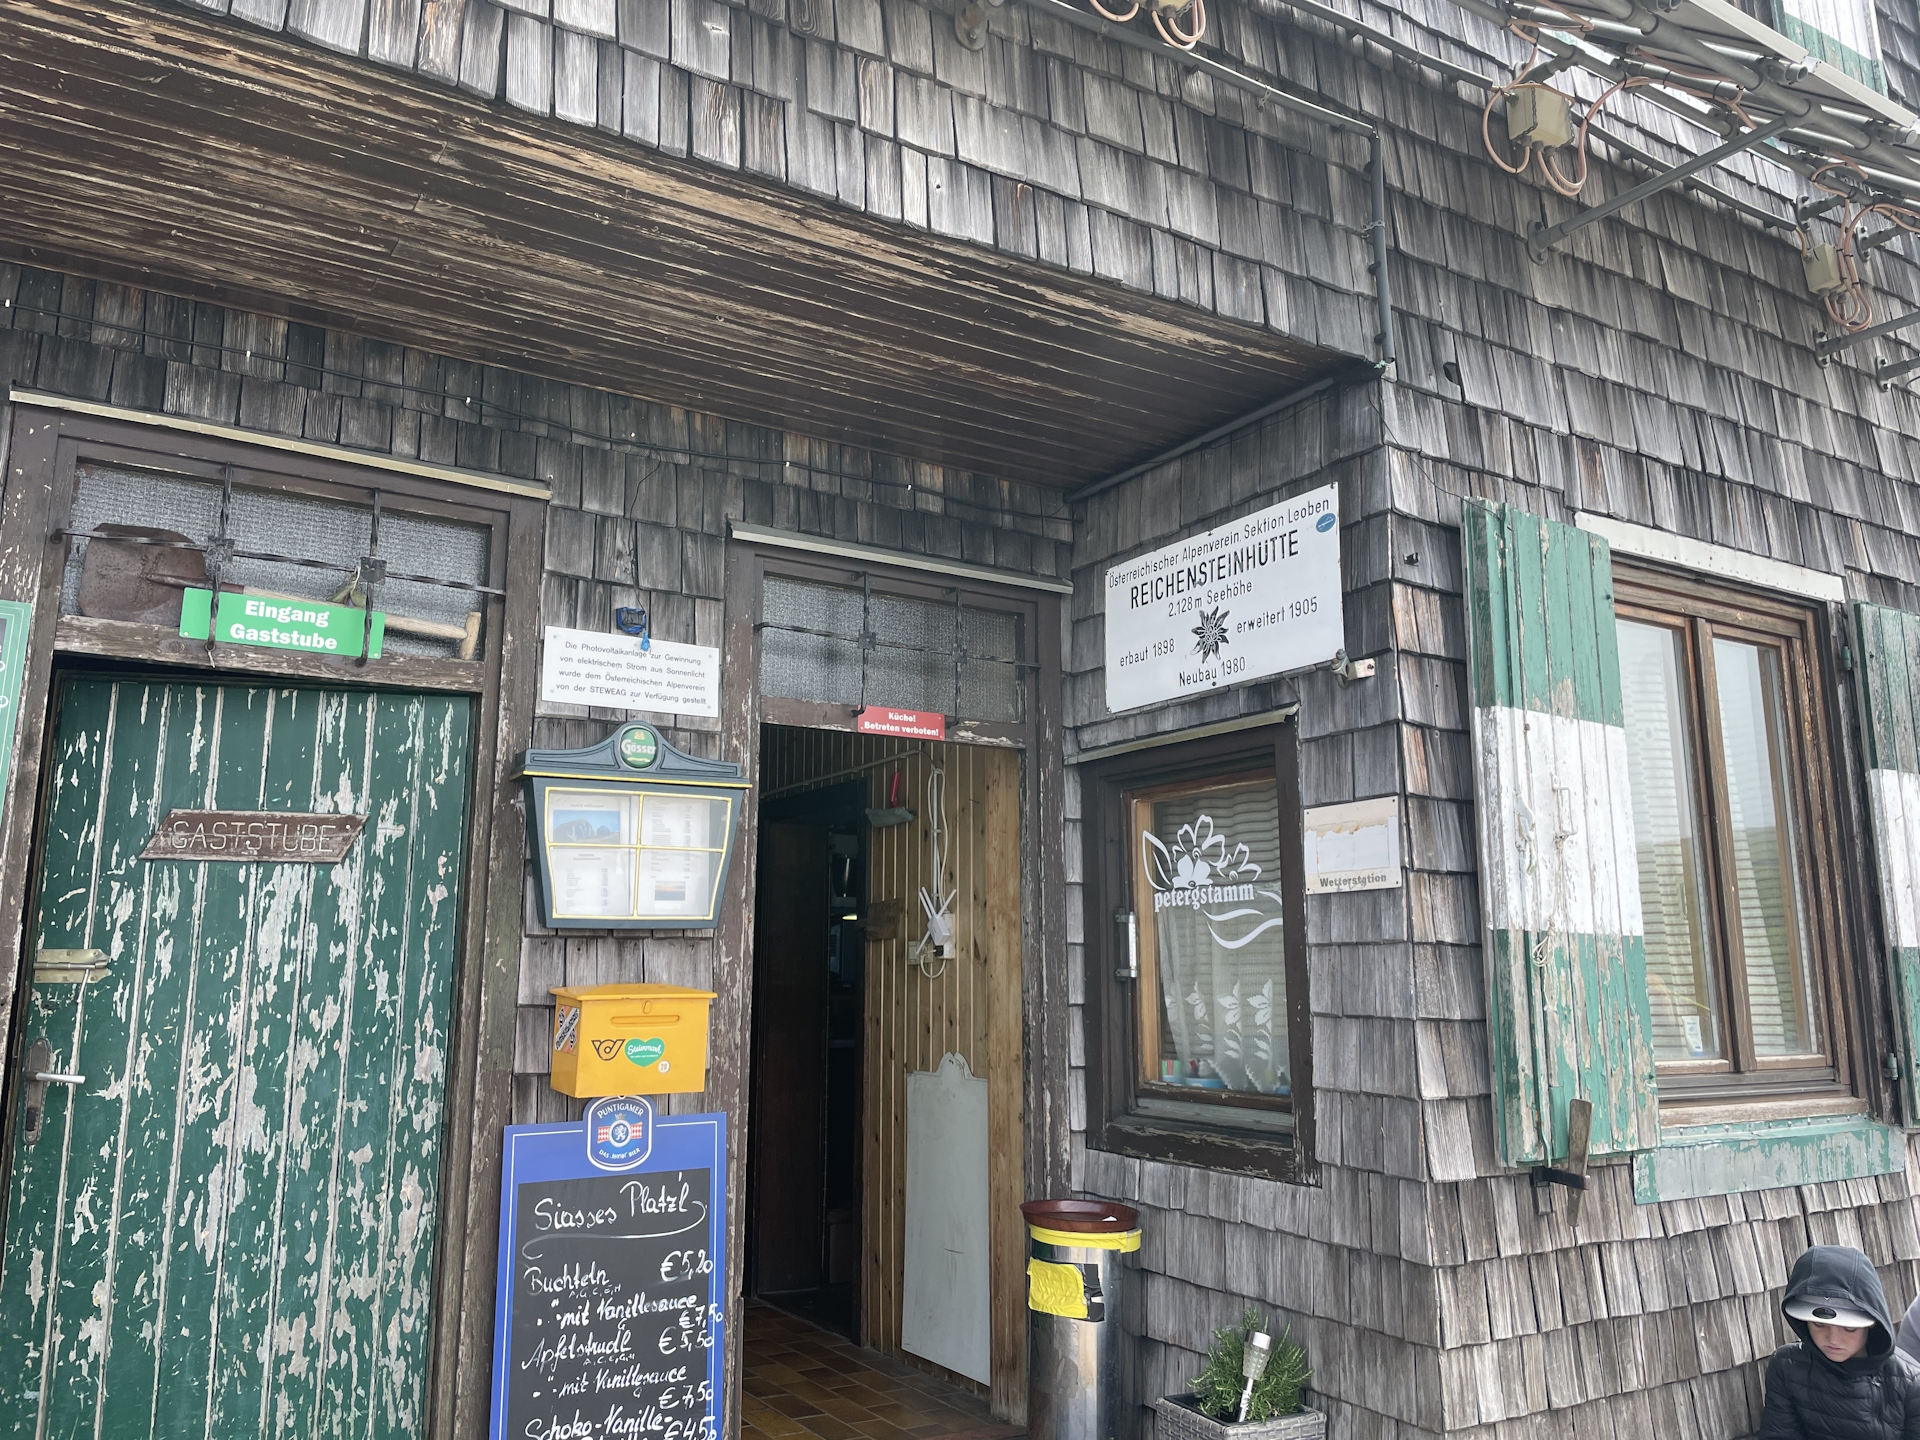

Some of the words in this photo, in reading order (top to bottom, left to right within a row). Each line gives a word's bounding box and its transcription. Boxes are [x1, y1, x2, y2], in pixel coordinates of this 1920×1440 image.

[1109, 554, 1179, 589] Österreichischer
[1244, 515, 1285, 540] Sektion
[1288, 499, 1330, 524] Leoben
[1130, 529, 1299, 610] REICHENSTEINHÜTTE
[1207, 579, 1253, 605] Seehöhe
[245, 599, 331, 628] Eingang
[1236, 607, 1286, 634] erweitert
[1289, 596, 1318, 619] 1905
[230, 623, 338, 651] Gaststube
[565, 641, 578, 650] Die
[581, 643, 648, 659] Photovoltaikanlage
[664, 653, 702, 666] Gewinnung
[1119, 644, 1149, 667] erbaut
[1153, 638, 1175, 658] 1898
[558, 670, 582, 678] wurde
[585, 672, 602, 680] dem
[605, 672, 663, 687] Österreichischen
[666, 680, 706, 692] Alpenverein
[577, 657, 623, 669] elektrischem
[626, 662, 647, 672] Strom
[650, 666, 663, 674] aus
[666, 667, 706, 679] Sonnenlicht
[1179, 668, 1217, 687] Neubau
[1221, 656, 1246, 678] 1980
[556, 683, 570, 691] von
[573, 684, 586, 692] der
[589, 686, 627, 697] STEWEAG
[644, 691, 679, 704] Verfügung
[682, 696, 707, 705] gestellt
[864, 721, 900, 732] Betreten
[901, 725, 939, 736] verboten!
[888, 711, 916, 723] Küche!
[620, 738, 657, 756] Gösser
[171, 819, 337, 853] GASTSTUBE
[1320, 873, 1387, 888] Wetterstation
[1154, 882, 1256, 914] petergstamm
[627, 1044, 662, 1056] Steiermark
[597, 1102, 644, 1119] PUNTIGAMER
[598, 1149, 610, 1159] DAS
[523, 1261, 610, 1296] Buchteln
[596, 1291, 698, 1321] Vanillesauce
[521, 1330, 632, 1373] Apfelstrudl
[594, 1362, 688, 1394] Vanillesauce
